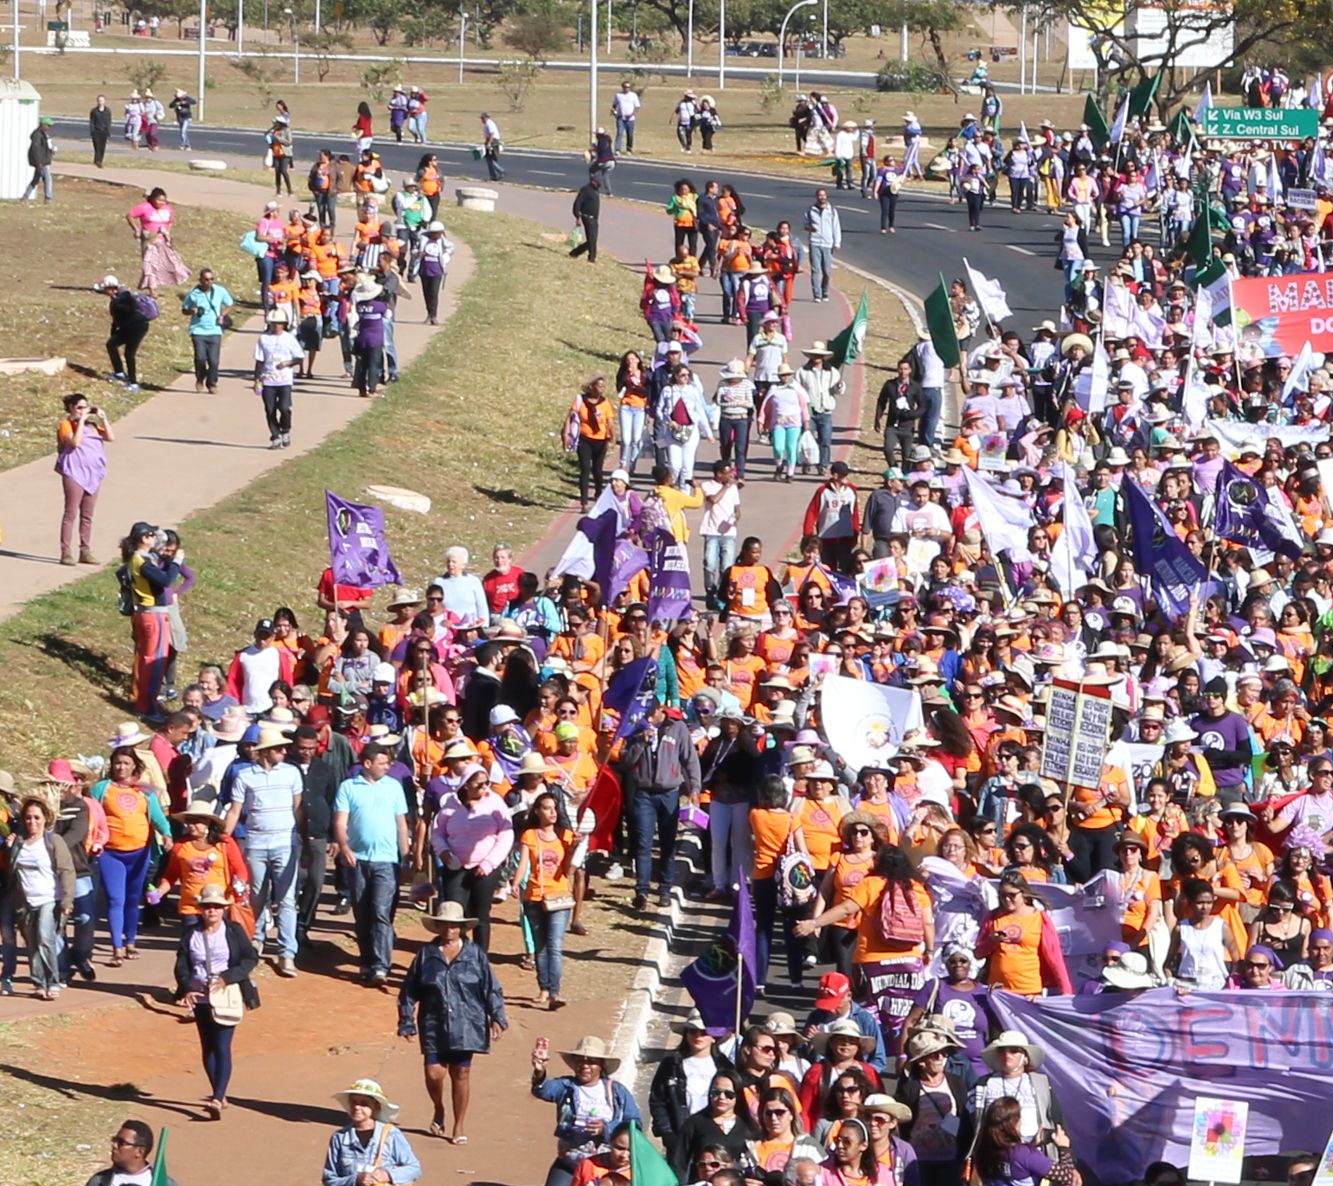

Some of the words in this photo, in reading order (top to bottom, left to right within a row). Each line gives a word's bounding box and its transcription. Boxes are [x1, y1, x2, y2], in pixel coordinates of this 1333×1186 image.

[1222, 109, 1239, 121] Via
[1242, 109, 1262, 121] W3
[1264, 109, 1283, 121] Sul
[1222, 124, 1233, 135] Z.
[1236, 124, 1275, 135] Central
[1277, 124, 1299, 136] Sul
